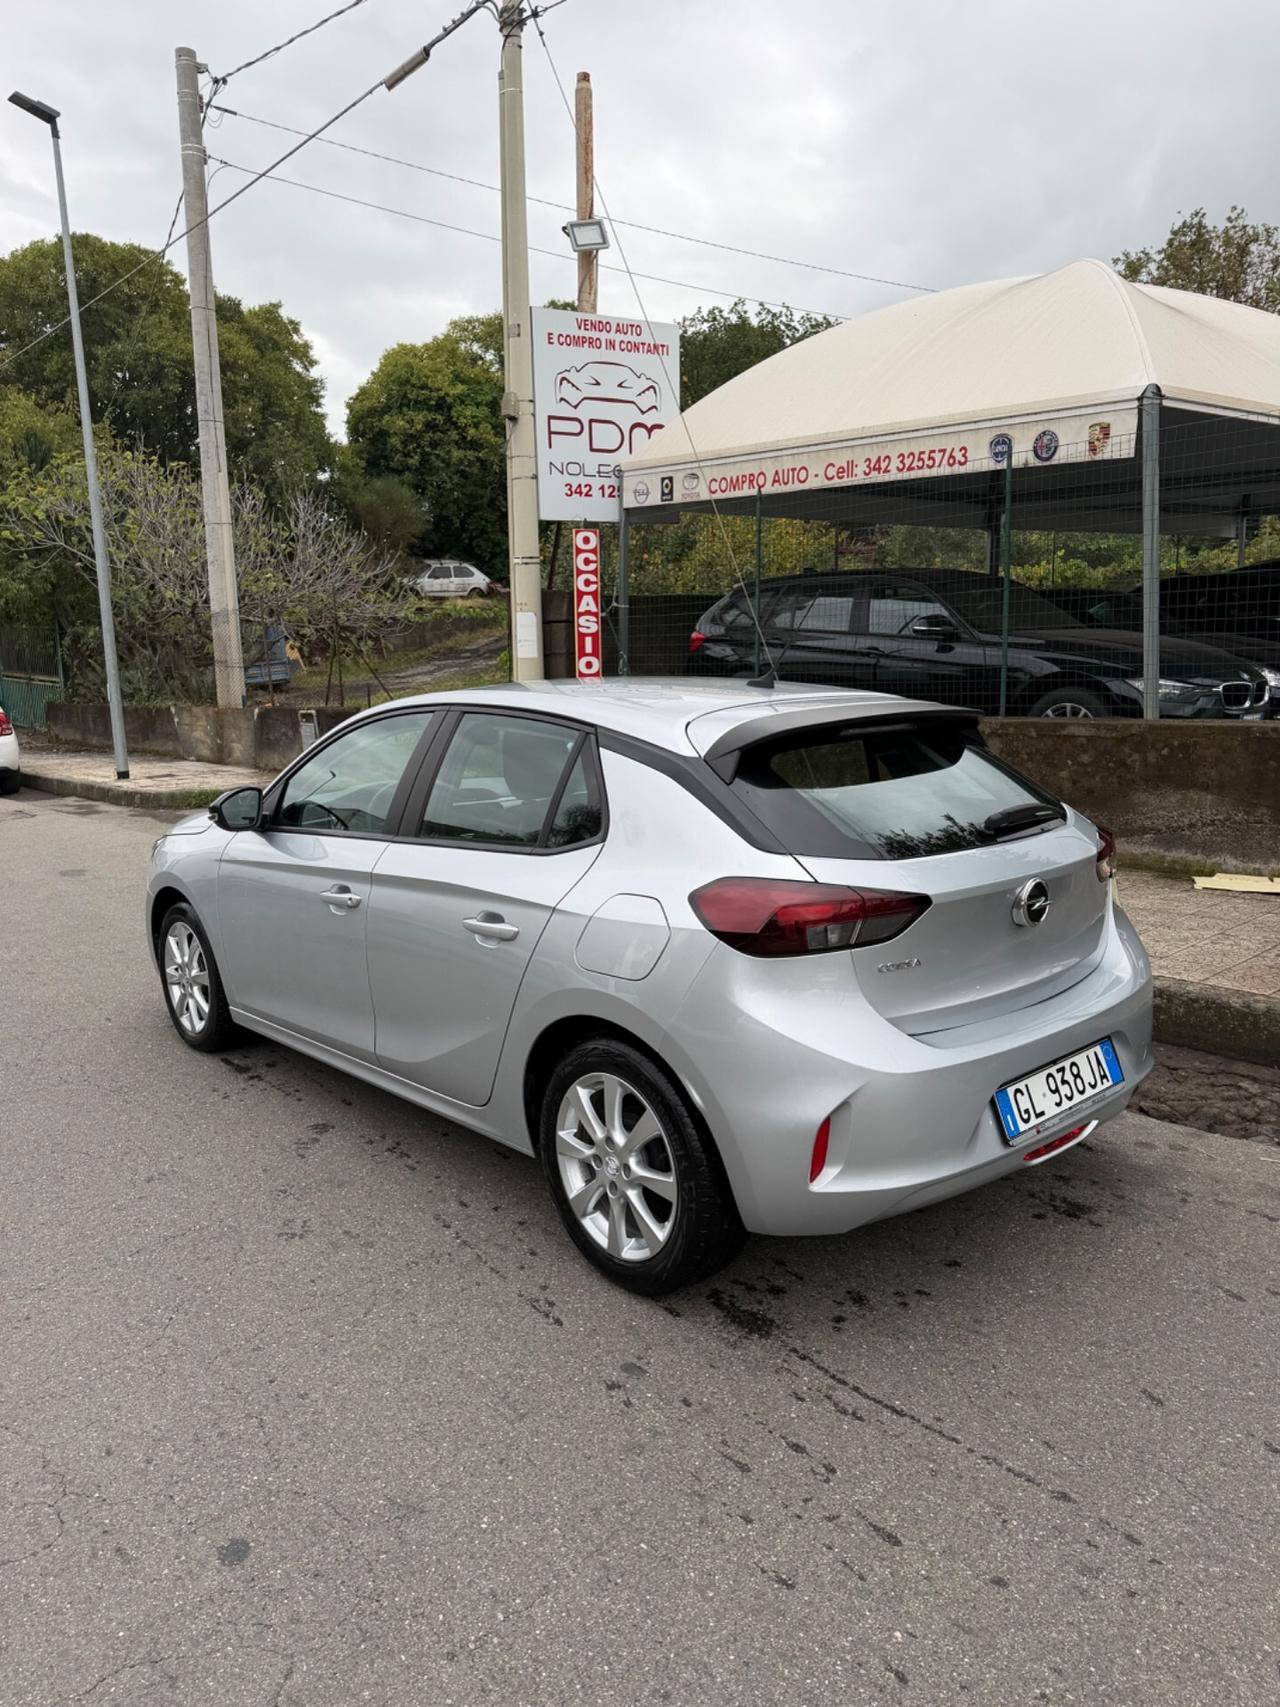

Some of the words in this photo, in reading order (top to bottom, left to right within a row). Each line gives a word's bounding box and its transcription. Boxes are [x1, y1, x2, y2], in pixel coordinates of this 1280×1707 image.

[576, 318, 612, 334] VENDO
[615, 323, 642, 337] AUTO
[547, 332, 554, 345] E
[557, 333, 602, 350] COMPRO
[605, 338, 616, 351] IN
[619, 340, 670, 356] CONTANTI
[708, 471, 767, 494] COMPRO
[771, 465, 809, 487] AUTO
[824, 460, 858, 481] Cell:
[863, 455, 892, 476] 342
[896, 446, 968, 473] 3255763
[564, 483, 593, 497] 342
[1013, 1083, 1046, 1124] GL
[1045, 1050, 1110, 1107] 938JA
